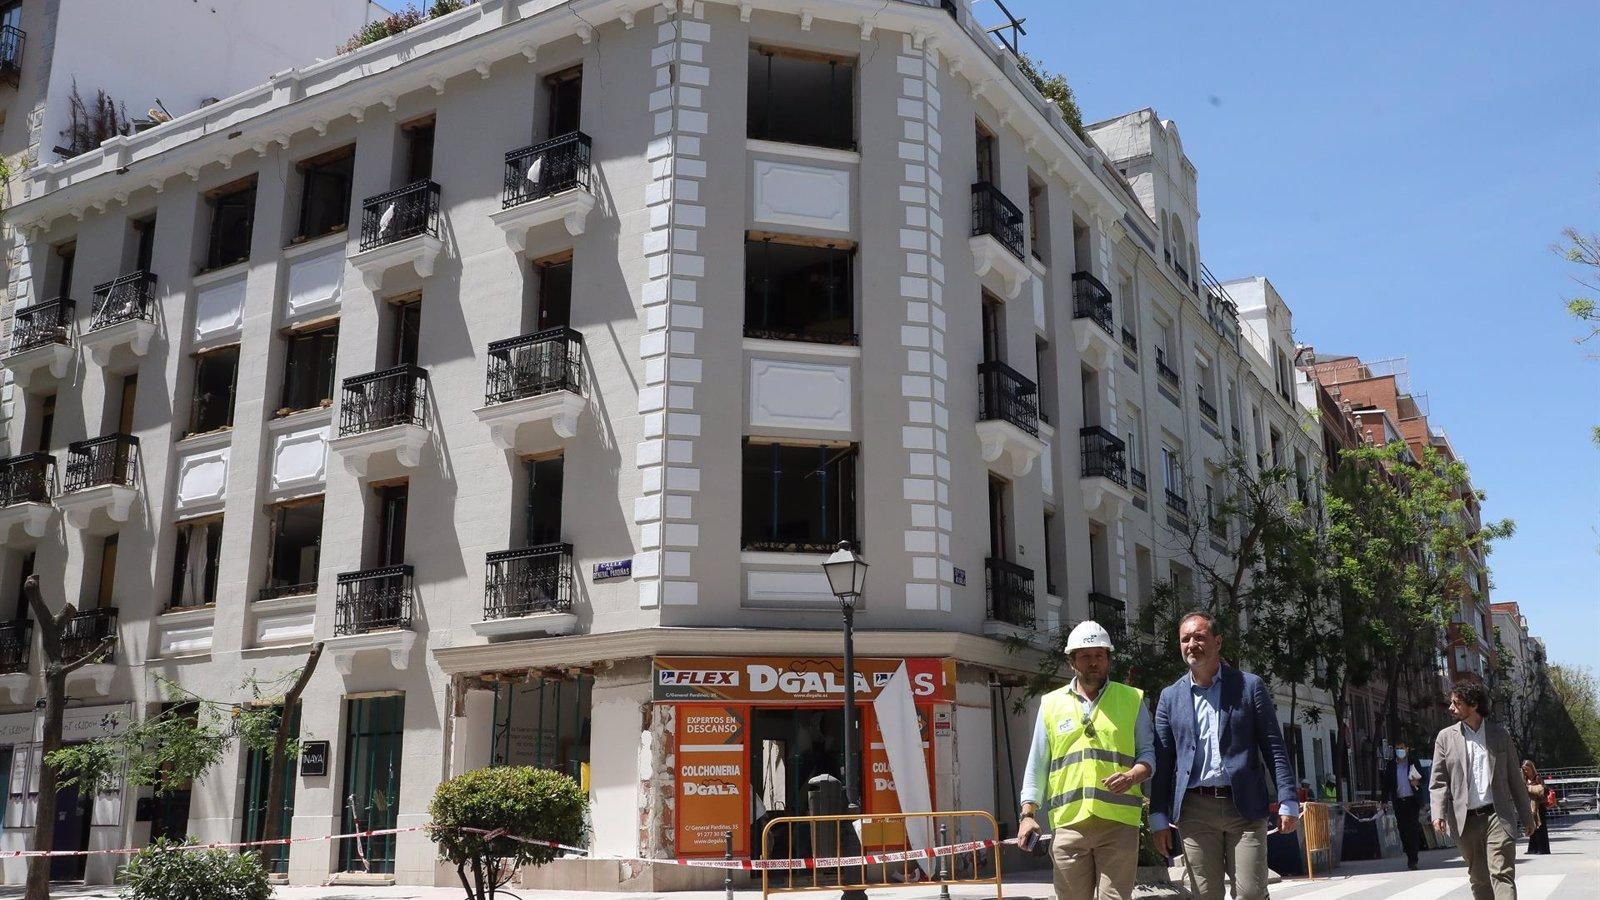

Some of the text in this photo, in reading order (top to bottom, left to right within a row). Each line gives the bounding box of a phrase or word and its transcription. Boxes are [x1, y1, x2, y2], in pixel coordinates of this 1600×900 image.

[675, 671, 734, 685] FLEX
[746, 664, 872, 693] D'GALA
[687, 716, 724, 724] EXPERTOS
[687, 724, 737, 733] DESCANSO
[681, 765, 741, 777] COLCHONERIA
